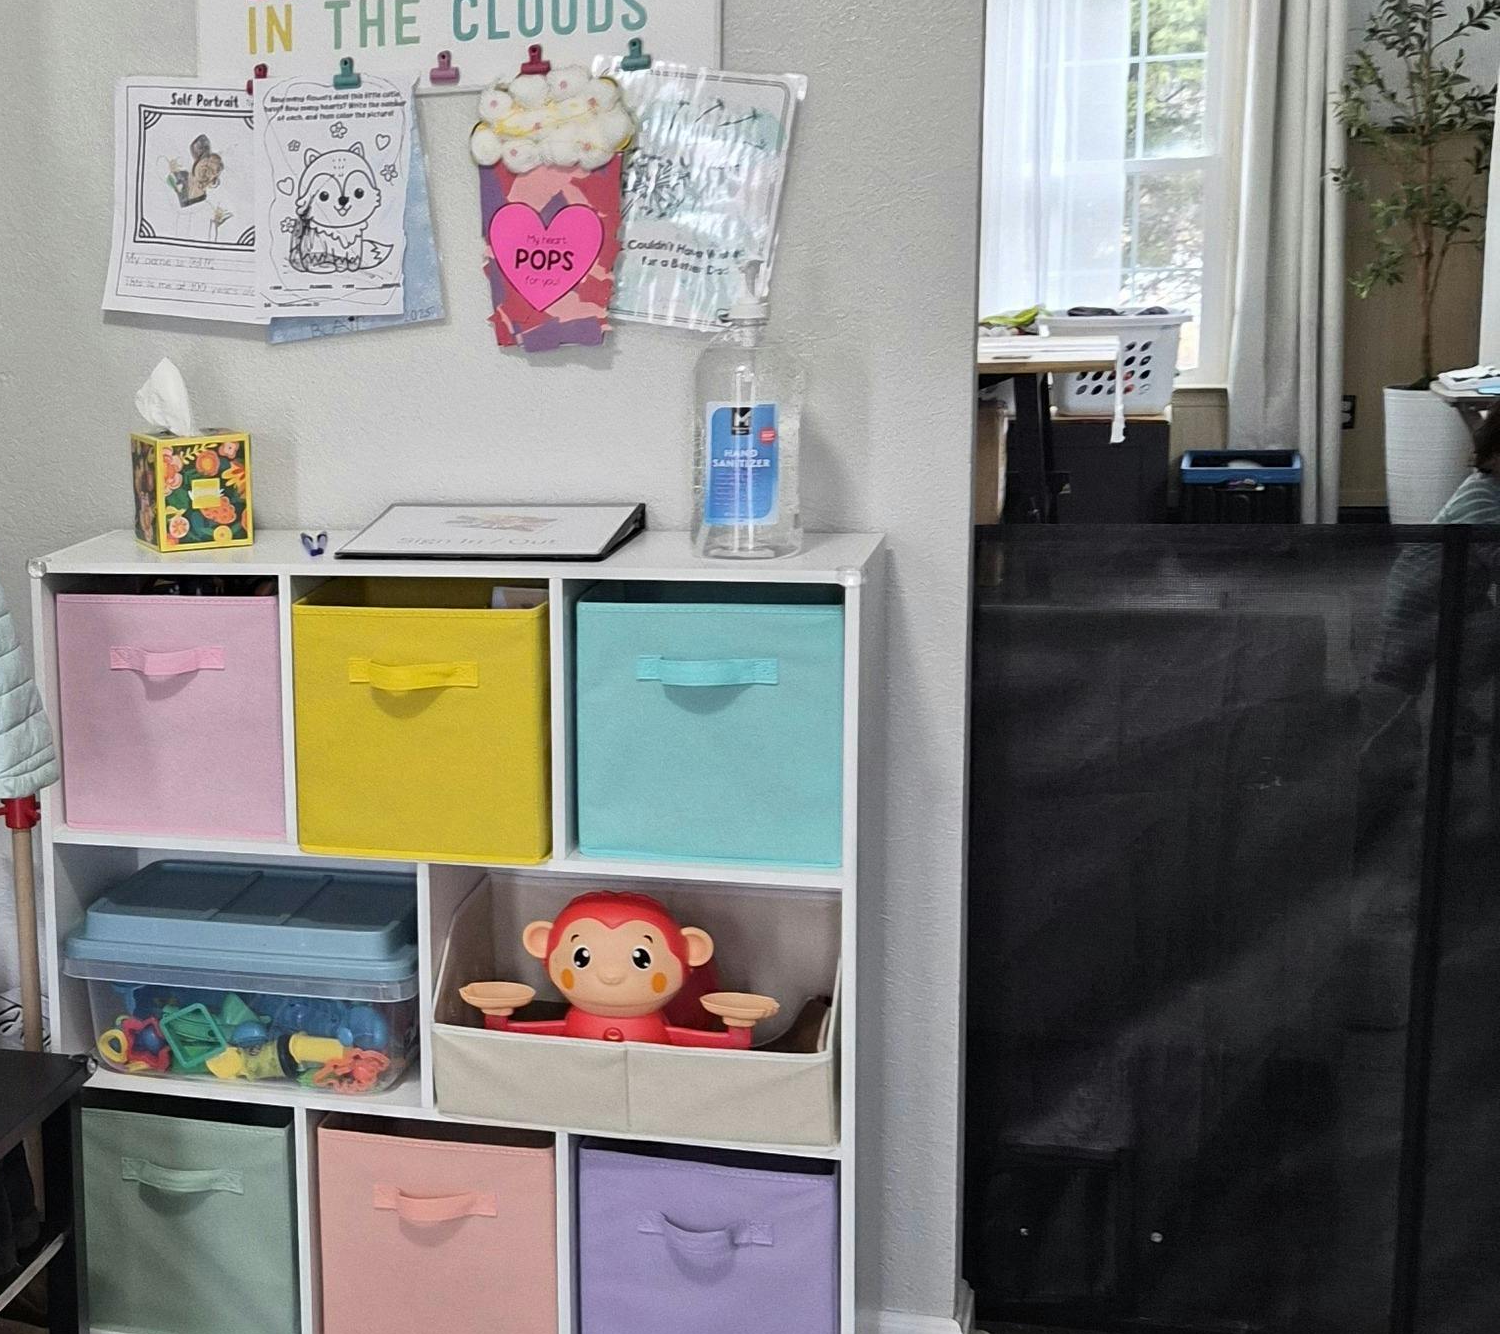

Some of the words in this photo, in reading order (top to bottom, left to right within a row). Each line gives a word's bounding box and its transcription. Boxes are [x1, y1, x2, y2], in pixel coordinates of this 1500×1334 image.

[248, 4, 293, 54] IN
[170, 93, 192, 107] Self
[196, 93, 239, 109] Portrait
[516, 248, 574, 271] POPS
[723, 449, 758, 458] HAND
[711, 458, 771, 468] SANITIZER
[397, 537, 451, 546] Sign
[508, 538, 557, 546] Out
